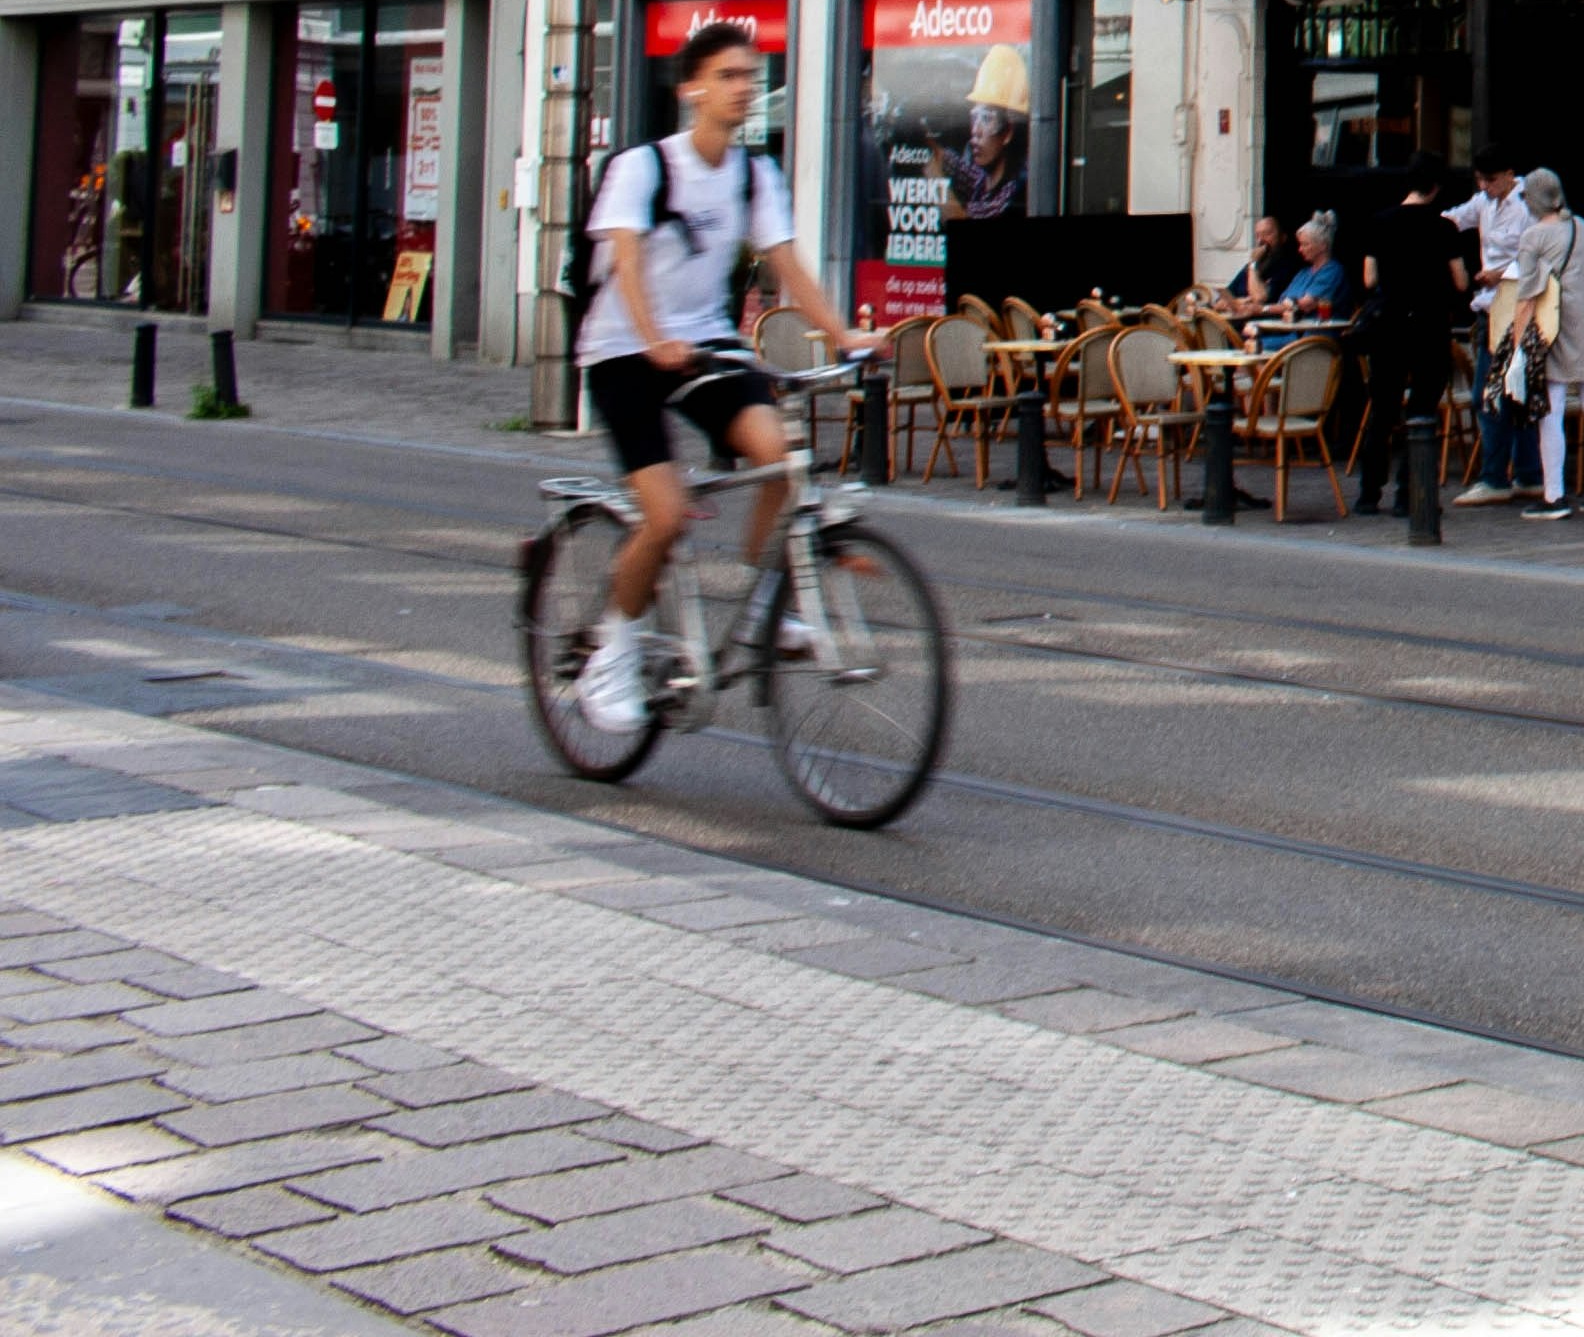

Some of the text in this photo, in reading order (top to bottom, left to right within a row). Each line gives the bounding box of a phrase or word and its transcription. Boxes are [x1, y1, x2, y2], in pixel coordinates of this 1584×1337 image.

[686, 8, 758, 42] Ado
[890, 144, 930, 164] Adecco
[888, 177, 950, 204] WERKT
[888, 205, 940, 232] VOOR
